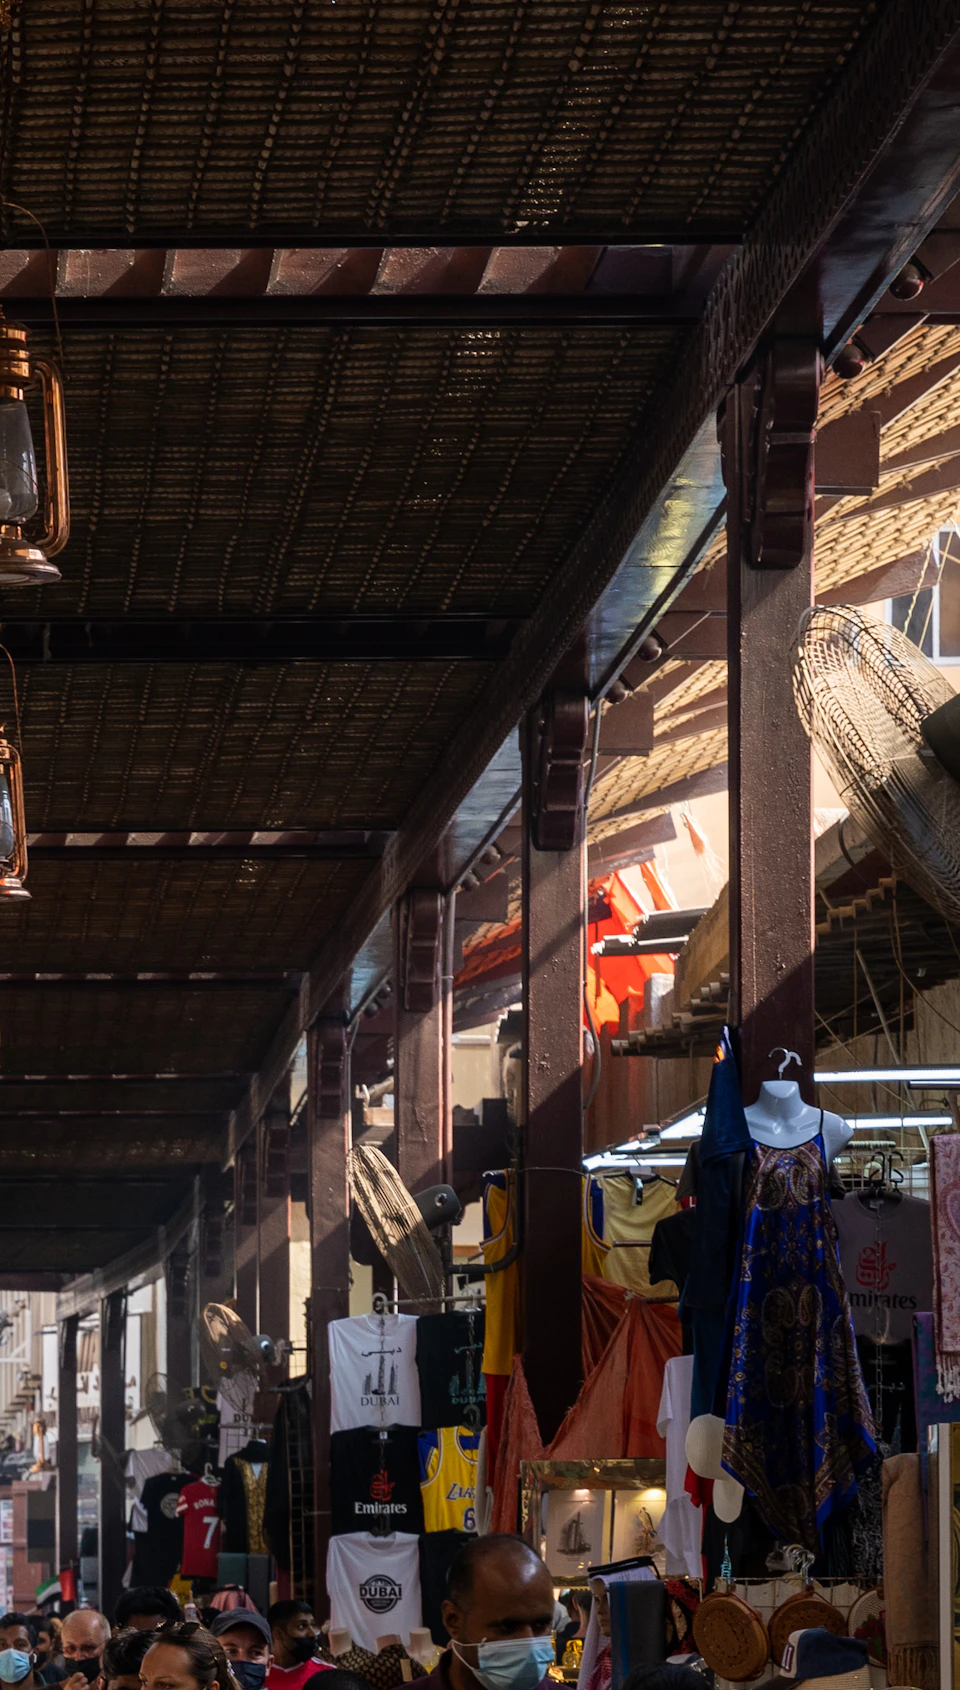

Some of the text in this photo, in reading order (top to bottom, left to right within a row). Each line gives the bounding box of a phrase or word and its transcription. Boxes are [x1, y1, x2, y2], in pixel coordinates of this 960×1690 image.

[849, 1290, 917, 1309] mirates
[360, 1396, 400, 1406] DUBAI
[451, 1396, 487, 1405] DUBA
[354, 1501, 408, 1515] Emirates
[203, 1516, 220, 1550] 7
[360, 1587, 402, 1597] DUBAI
